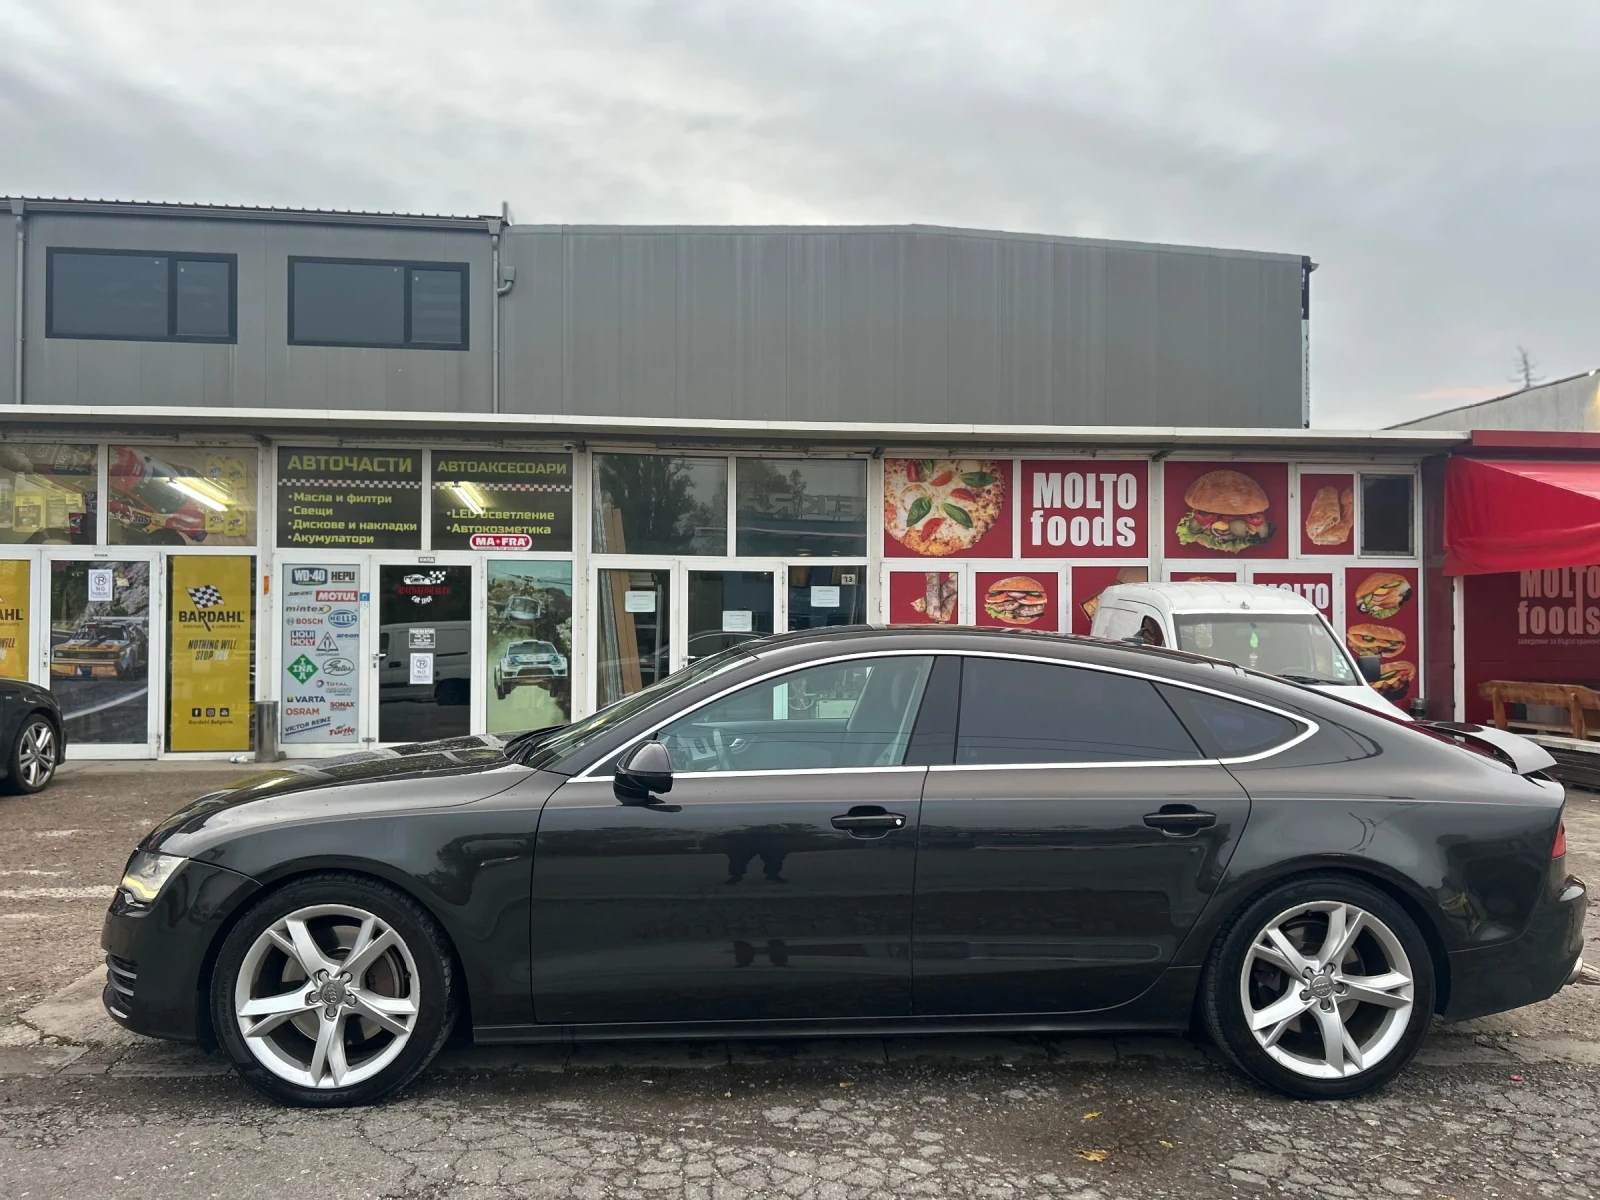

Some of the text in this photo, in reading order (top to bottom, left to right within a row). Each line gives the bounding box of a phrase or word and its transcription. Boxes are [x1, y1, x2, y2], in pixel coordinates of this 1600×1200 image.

[287, 455, 412, 472] АВТОЧАСТИ
[437, 461, 567, 474] АВТОАКСЕСОАРИ
[1033, 472, 1137, 510] MOLTO
[294, 492, 392, 505] Масла и филтри
[293, 506, 333, 516] Свещи
[451, 509, 555, 520] LED осветление
[293, 519, 345, 530] Дискове
[359, 522, 417, 532] накладки
[451, 524, 552, 534] Автокозметика
[1031, 510, 1136, 547] foods
[293, 533, 374, 544] Акумулатори
[331, 572, 355, 580] HEPU
[1520, 566, 1600, 598] MOLTO
[318, 592, 356, 600] MOTUL
[179, 611, 244, 622] BARDAHL
[330, 614, 357, 622] HELLA
[1518, 600, 1600, 634] foods
[188, 640, 237, 650] NOTHING WILL
[196, 651, 213, 660] STOP
[285, 716, 332, 732] VICTOR REINZ
[329, 727, 356, 736] Turtle
